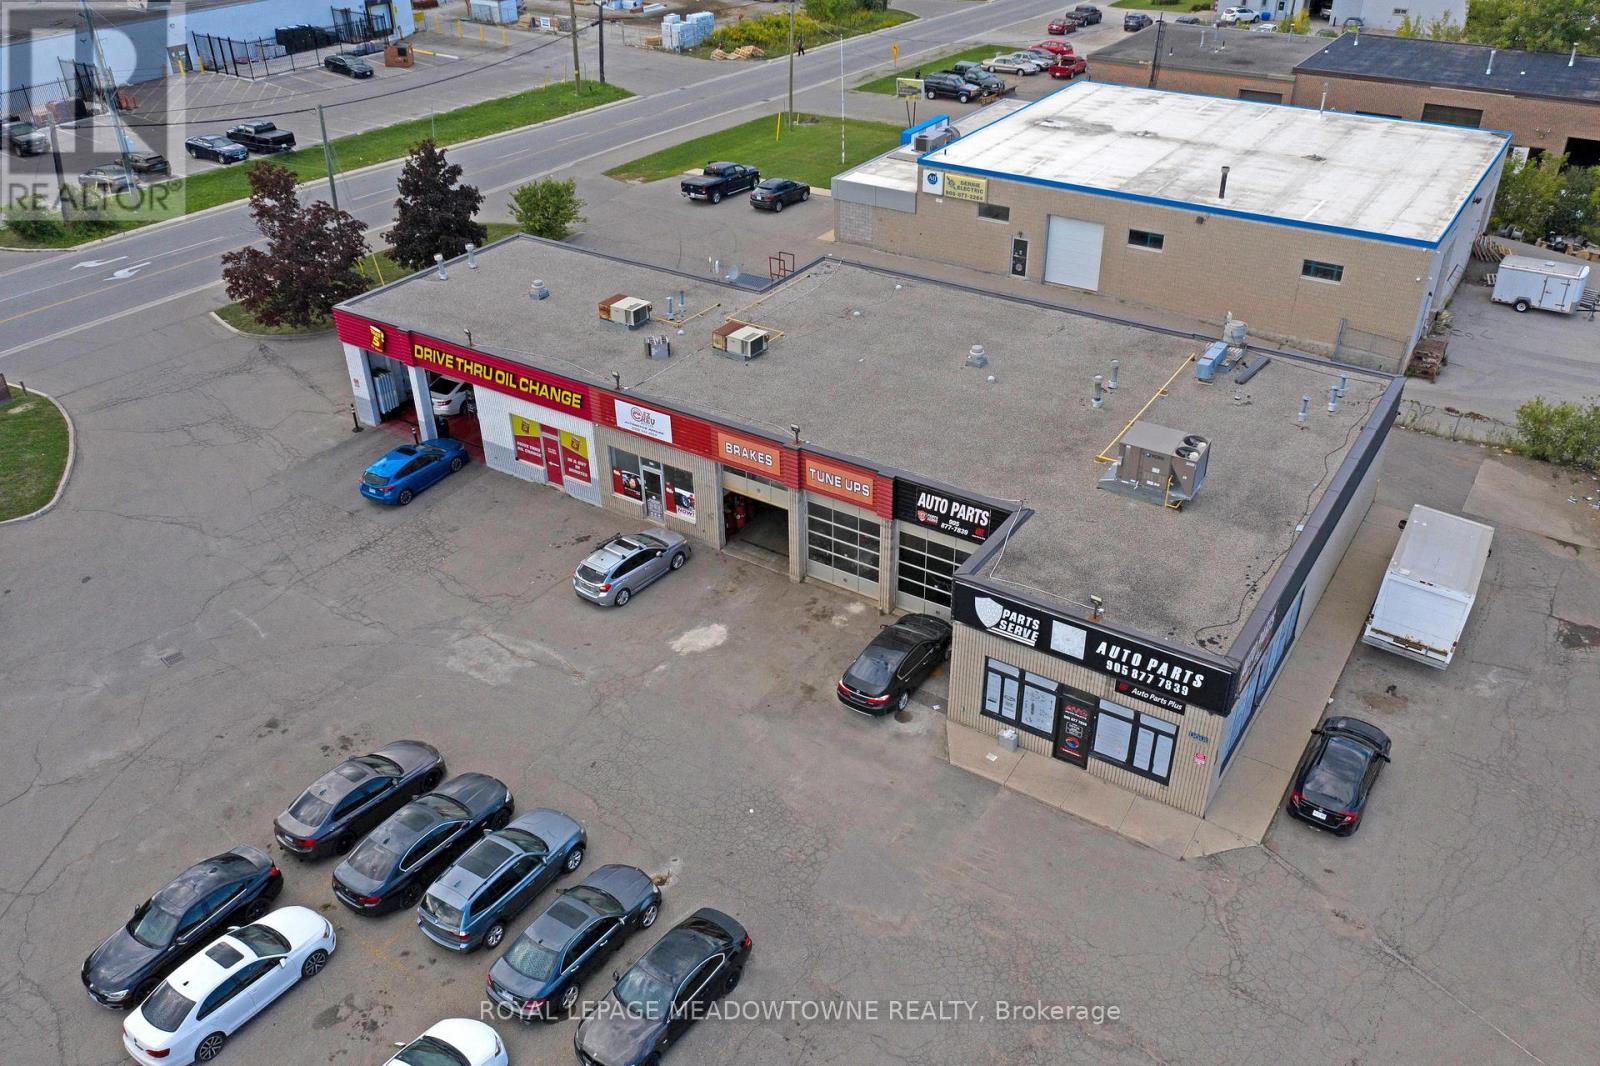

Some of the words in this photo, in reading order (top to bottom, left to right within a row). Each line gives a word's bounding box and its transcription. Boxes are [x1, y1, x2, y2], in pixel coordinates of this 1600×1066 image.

[957, 185, 984, 194] ELECTRIC
[373, 335, 380, 347] 5
[414, 344, 454, 368] DRIVE
[456, 357, 493, 380] THRU
[495, 370, 517, 389] OIL
[519, 377, 582, 409] CHANGE
[724, 441, 773, 467] BRAKES
[809, 467, 842, 488] TUNE
[845, 480, 870, 497] UPS
[917, 492, 949, 514] AUTO
[950, 501, 990, 527] PARTS
[948, 519, 960, 527] 905
[999, 619, 1039, 642] SERVE
[1001, 608, 1040, 630] PARTS
[1096, 641, 1143, 667] AUTO
[1146, 657, 1204, 688] PARTS
[1106, 659, 1129, 676] 905
[1131, 668, 1155, 684] 877
[1158, 677, 1189, 696] 7839
[1131, 687, 1149, 699] Auto
[1149, 693, 1168, 705] Parts
[1167, 700, 1183, 711] Plus
